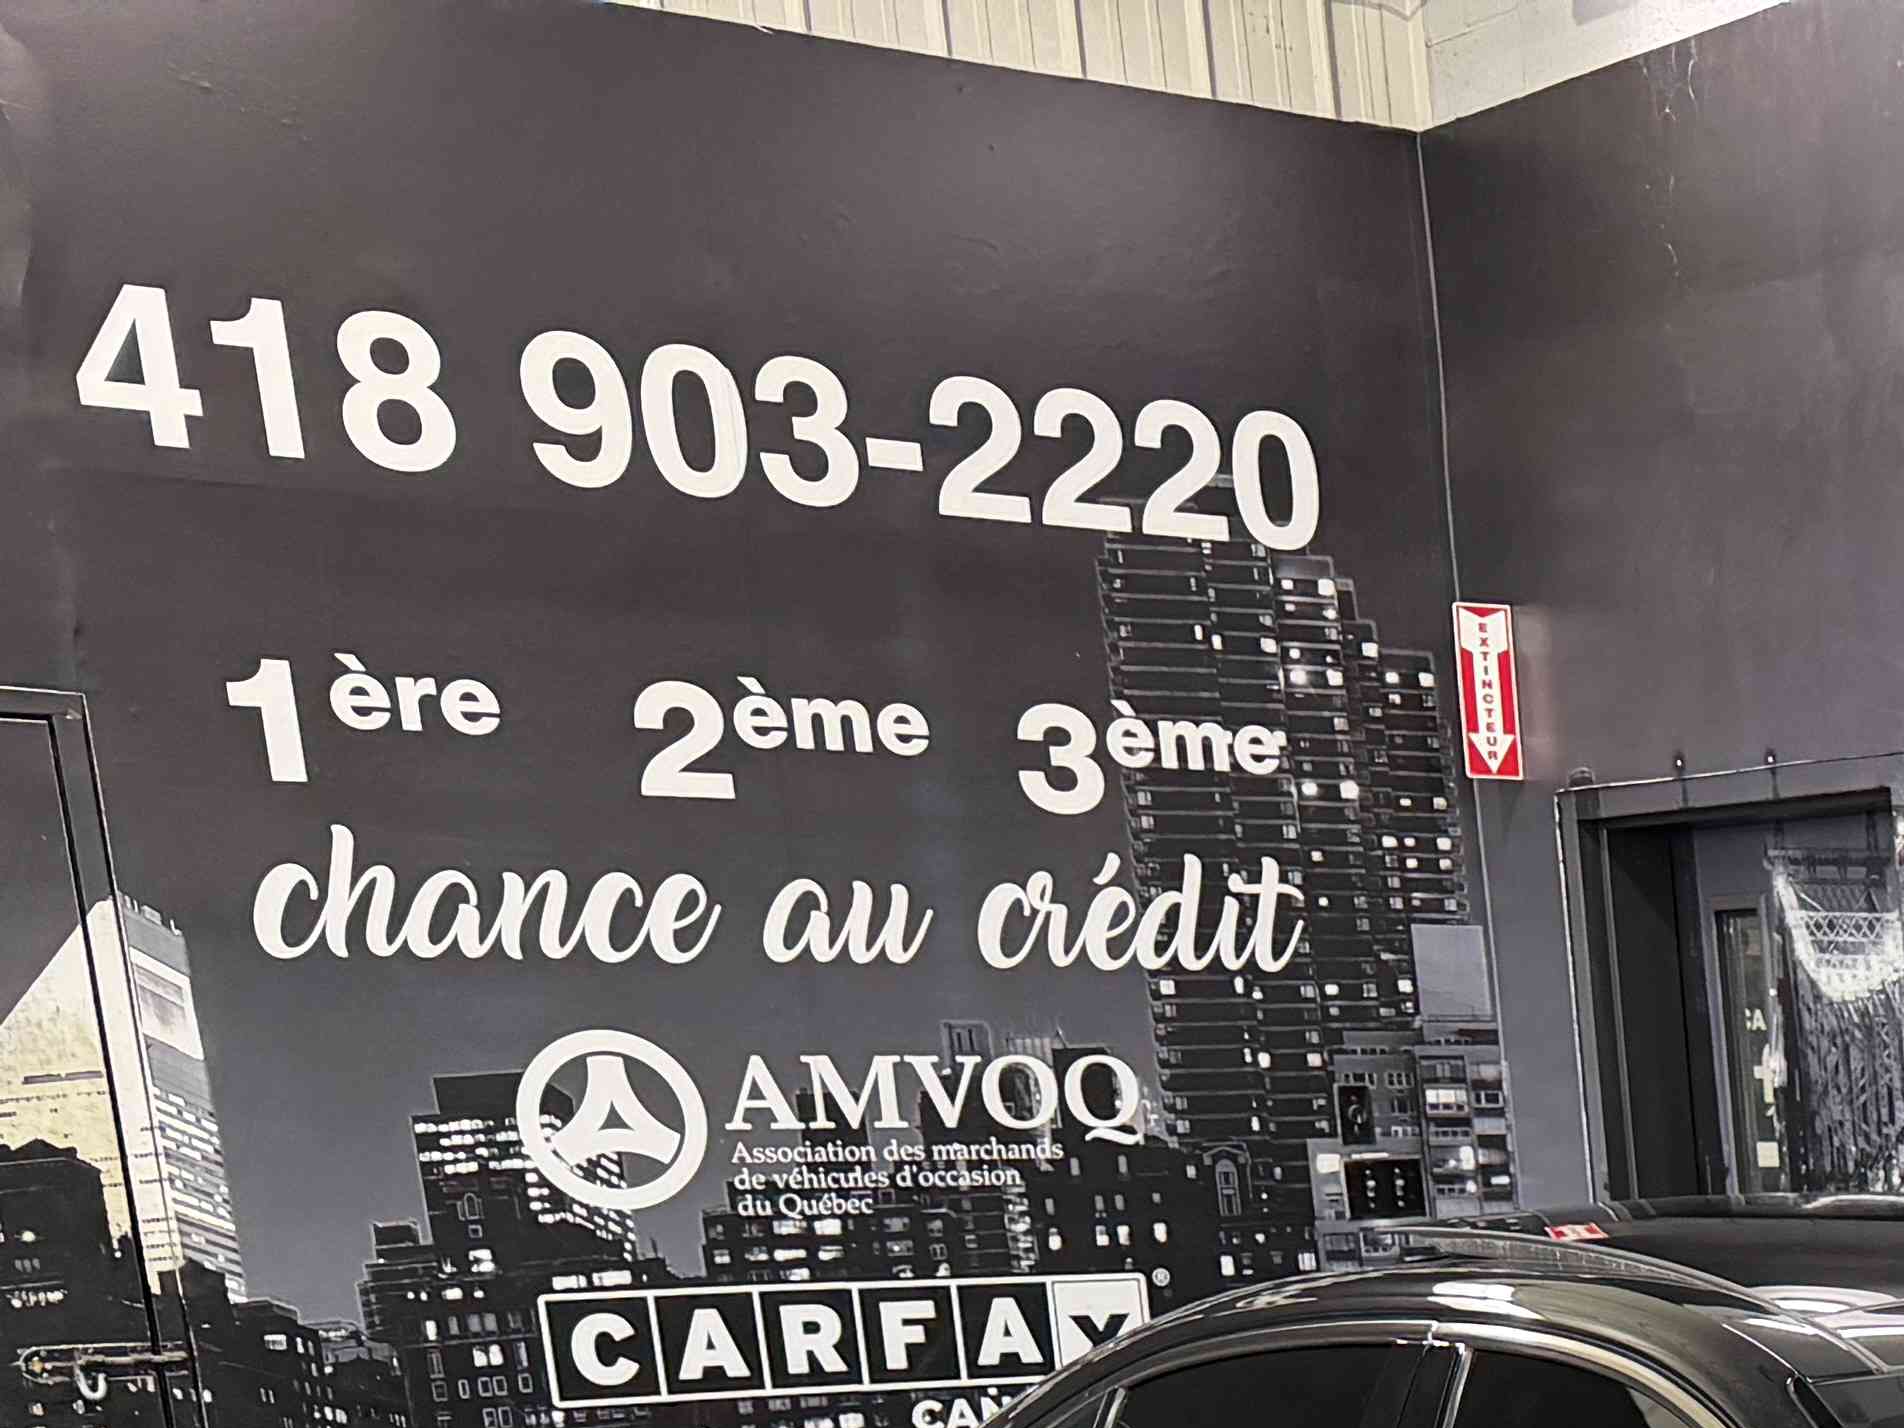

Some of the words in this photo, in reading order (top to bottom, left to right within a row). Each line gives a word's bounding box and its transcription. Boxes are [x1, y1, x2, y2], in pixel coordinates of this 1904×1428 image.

[75, 284, 457, 473] 418
[520, 330, 1320, 551] 903-2220
[226, 654, 501, 783] 1ère
[633, 678, 930, 800] 2ème
[1017, 700, 1287, 816] 3ème
[1477, 622, 1498, 761] EXTINCTEUR
[253, 822, 722, 964] chance
[762, 878, 934, 966] au
[977, 853, 1305, 973] crédit
[724, 1054, 1141, 1145] AMVOQ
[731, 1140, 877, 1164] Association
[883, 1139, 925, 1163] des
[931, 1136, 1064, 1161] marchands
[733, 1167, 766, 1190] de
[773, 1164, 890, 1190] véhicules
[895, 1164, 1023, 1187] d'occasion
[737, 1194, 772, 1217] du
[778, 1191, 874, 1220] Québec
